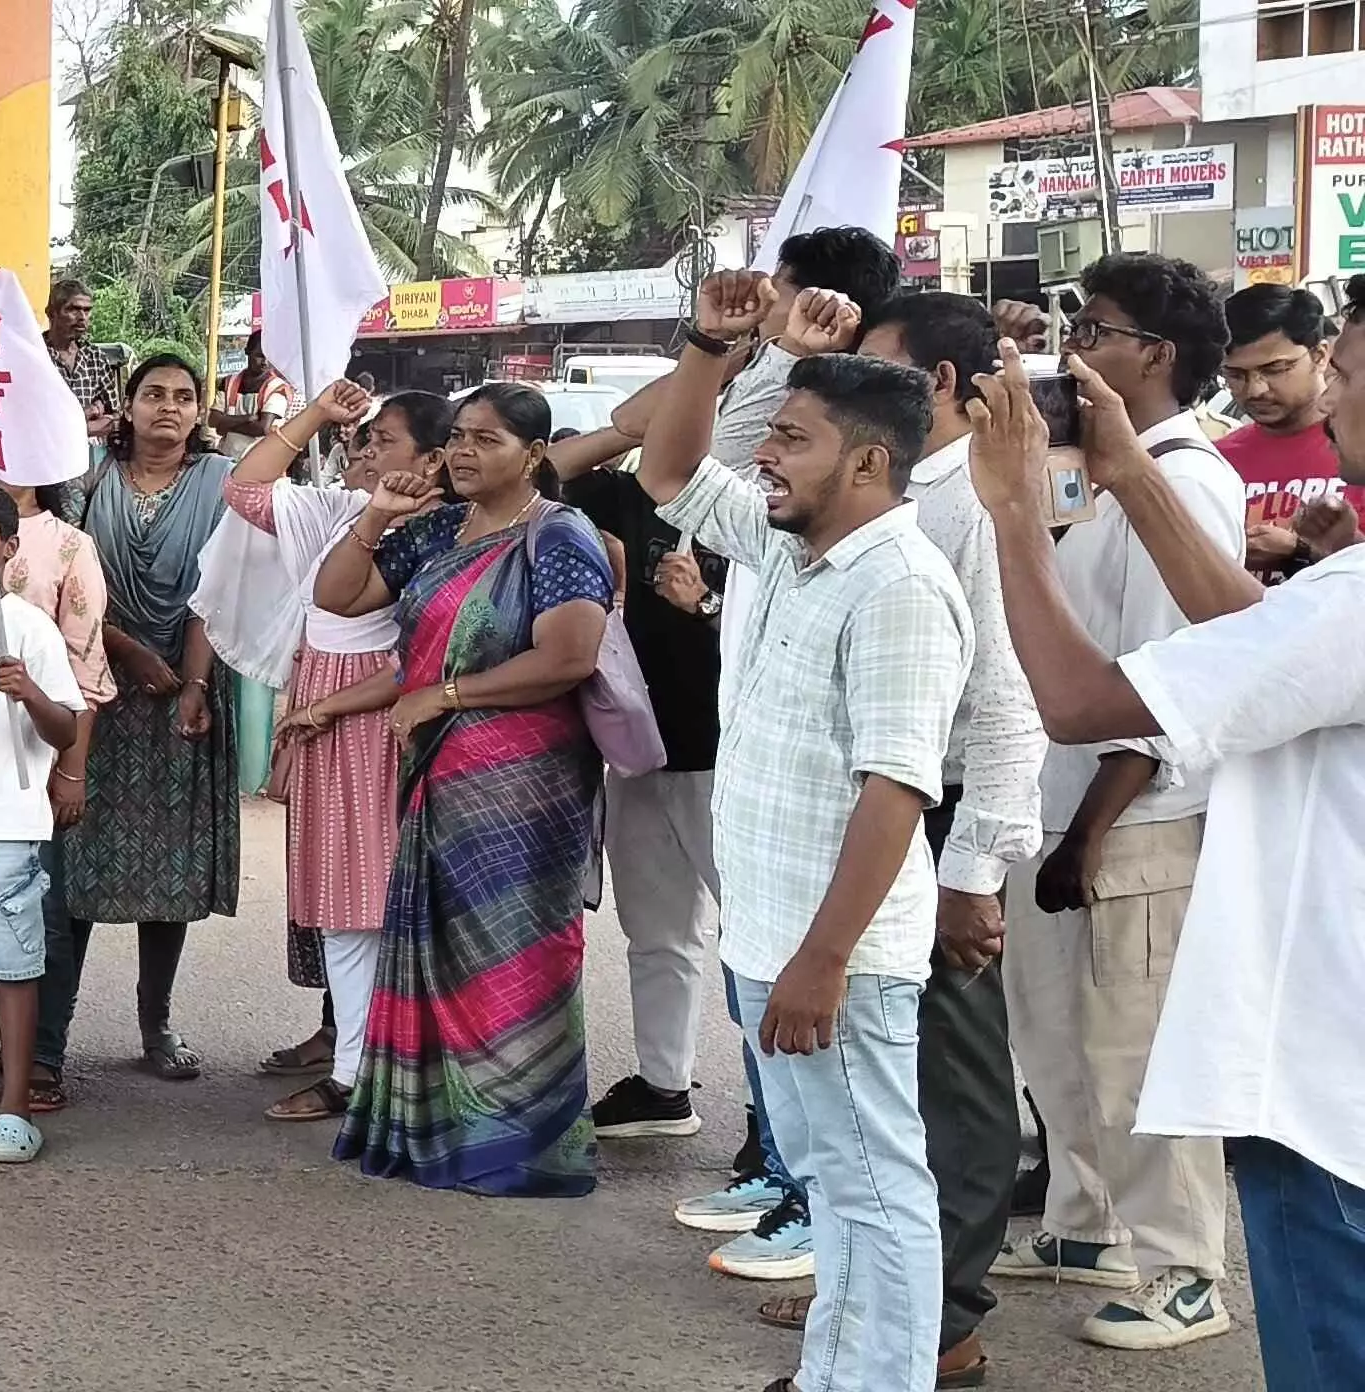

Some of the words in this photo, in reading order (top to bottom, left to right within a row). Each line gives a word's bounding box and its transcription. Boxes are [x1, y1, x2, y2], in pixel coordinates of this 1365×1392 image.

[1120, 167, 1165, 187] EARTH
[1170, 163, 1226, 182] MOVERS
[395, 291, 437, 306] BIRIYANI
[401, 308, 429, 319] DHABA
